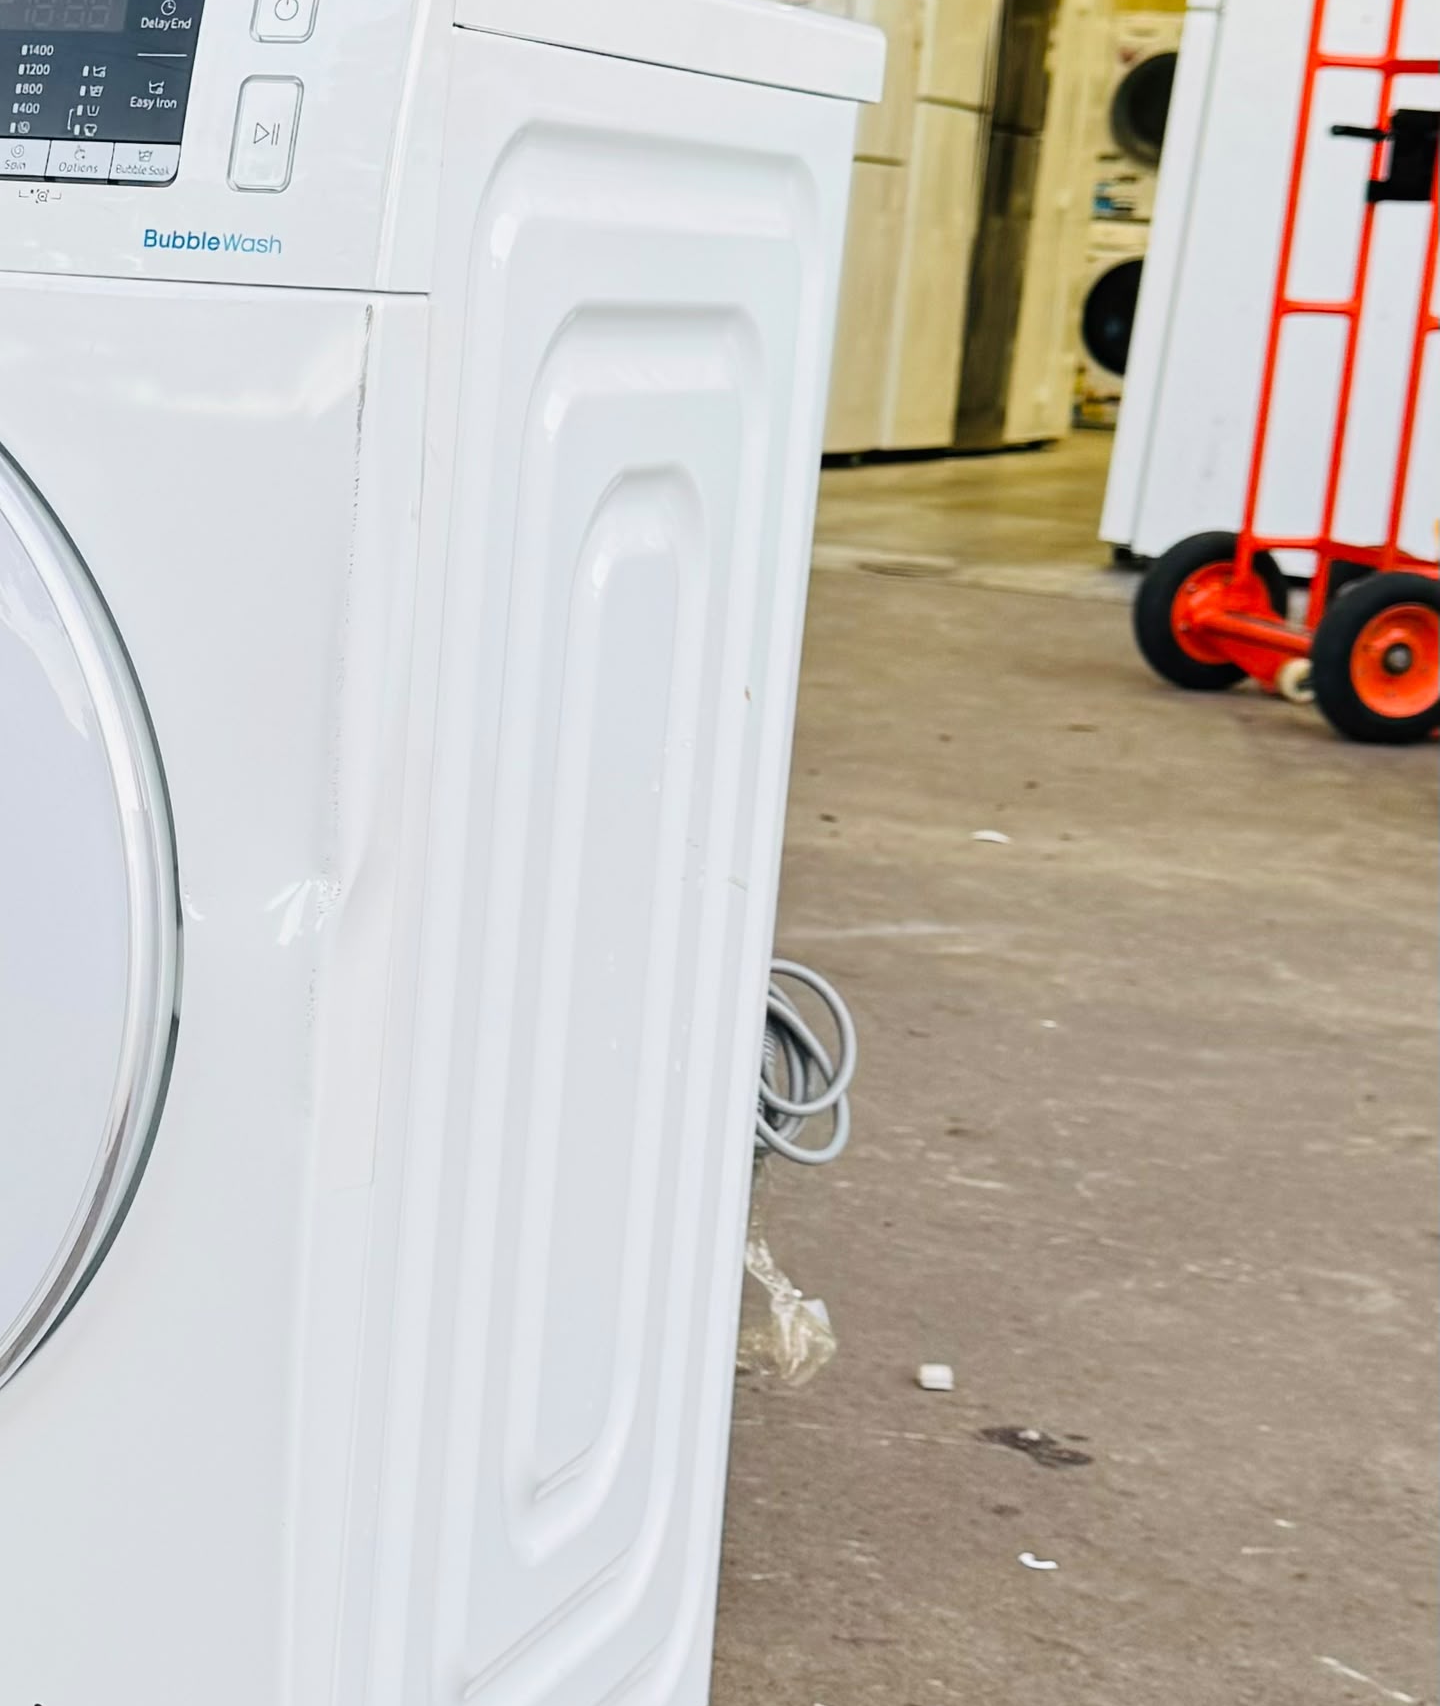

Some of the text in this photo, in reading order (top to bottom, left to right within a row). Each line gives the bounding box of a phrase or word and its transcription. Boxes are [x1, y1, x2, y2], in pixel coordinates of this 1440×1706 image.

[140, 17, 192, 31] Delay End
[28, 44, 54, 56] 1400
[25, 64, 51, 75] 1200
[21, 83, 43, 95] 800
[18, 103, 40, 114] 400
[130, 96, 177, 111] Easy Iron
[58, 162, 98, 174] Options
